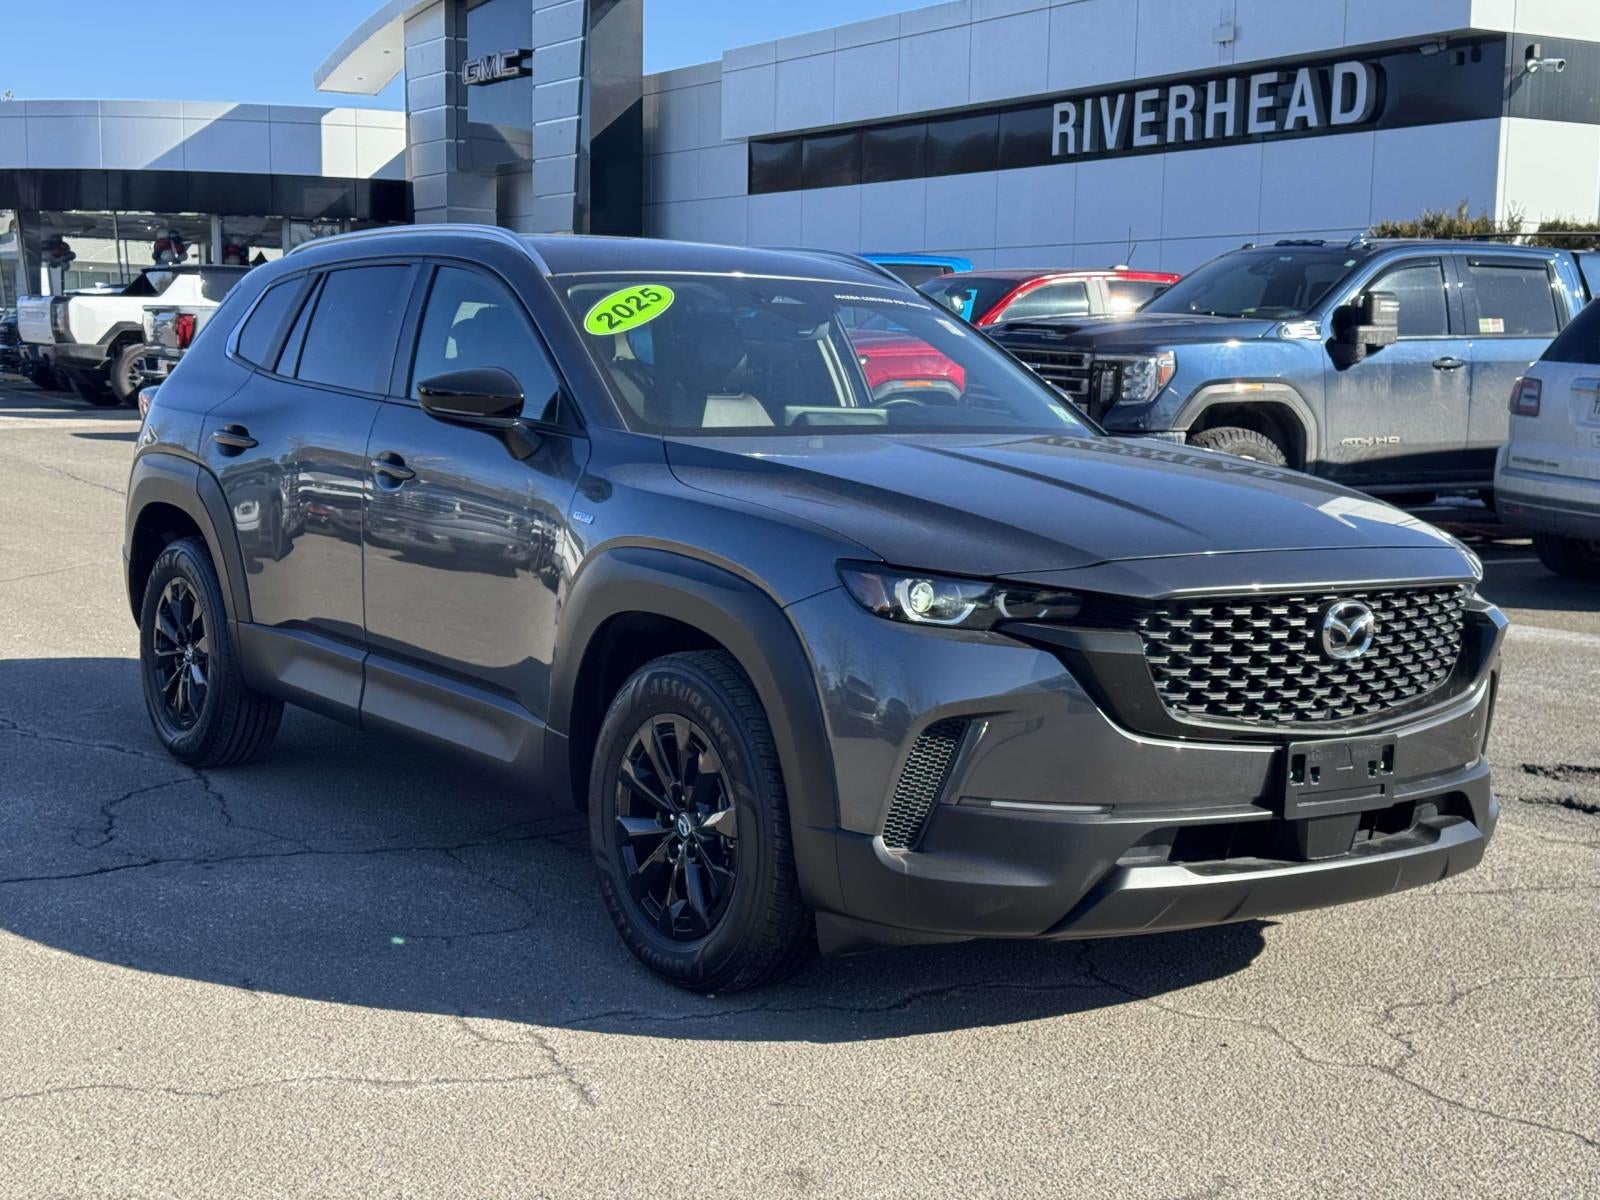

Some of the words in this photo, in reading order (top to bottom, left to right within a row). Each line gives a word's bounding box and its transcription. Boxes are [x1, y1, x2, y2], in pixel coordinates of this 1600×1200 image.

[462, 49, 519, 85] GMC
[1051, 60, 1369, 156] RIVERHEAD
[596, 287, 663, 330] 2025
[650, 678, 740, 766] ASSURANCE
